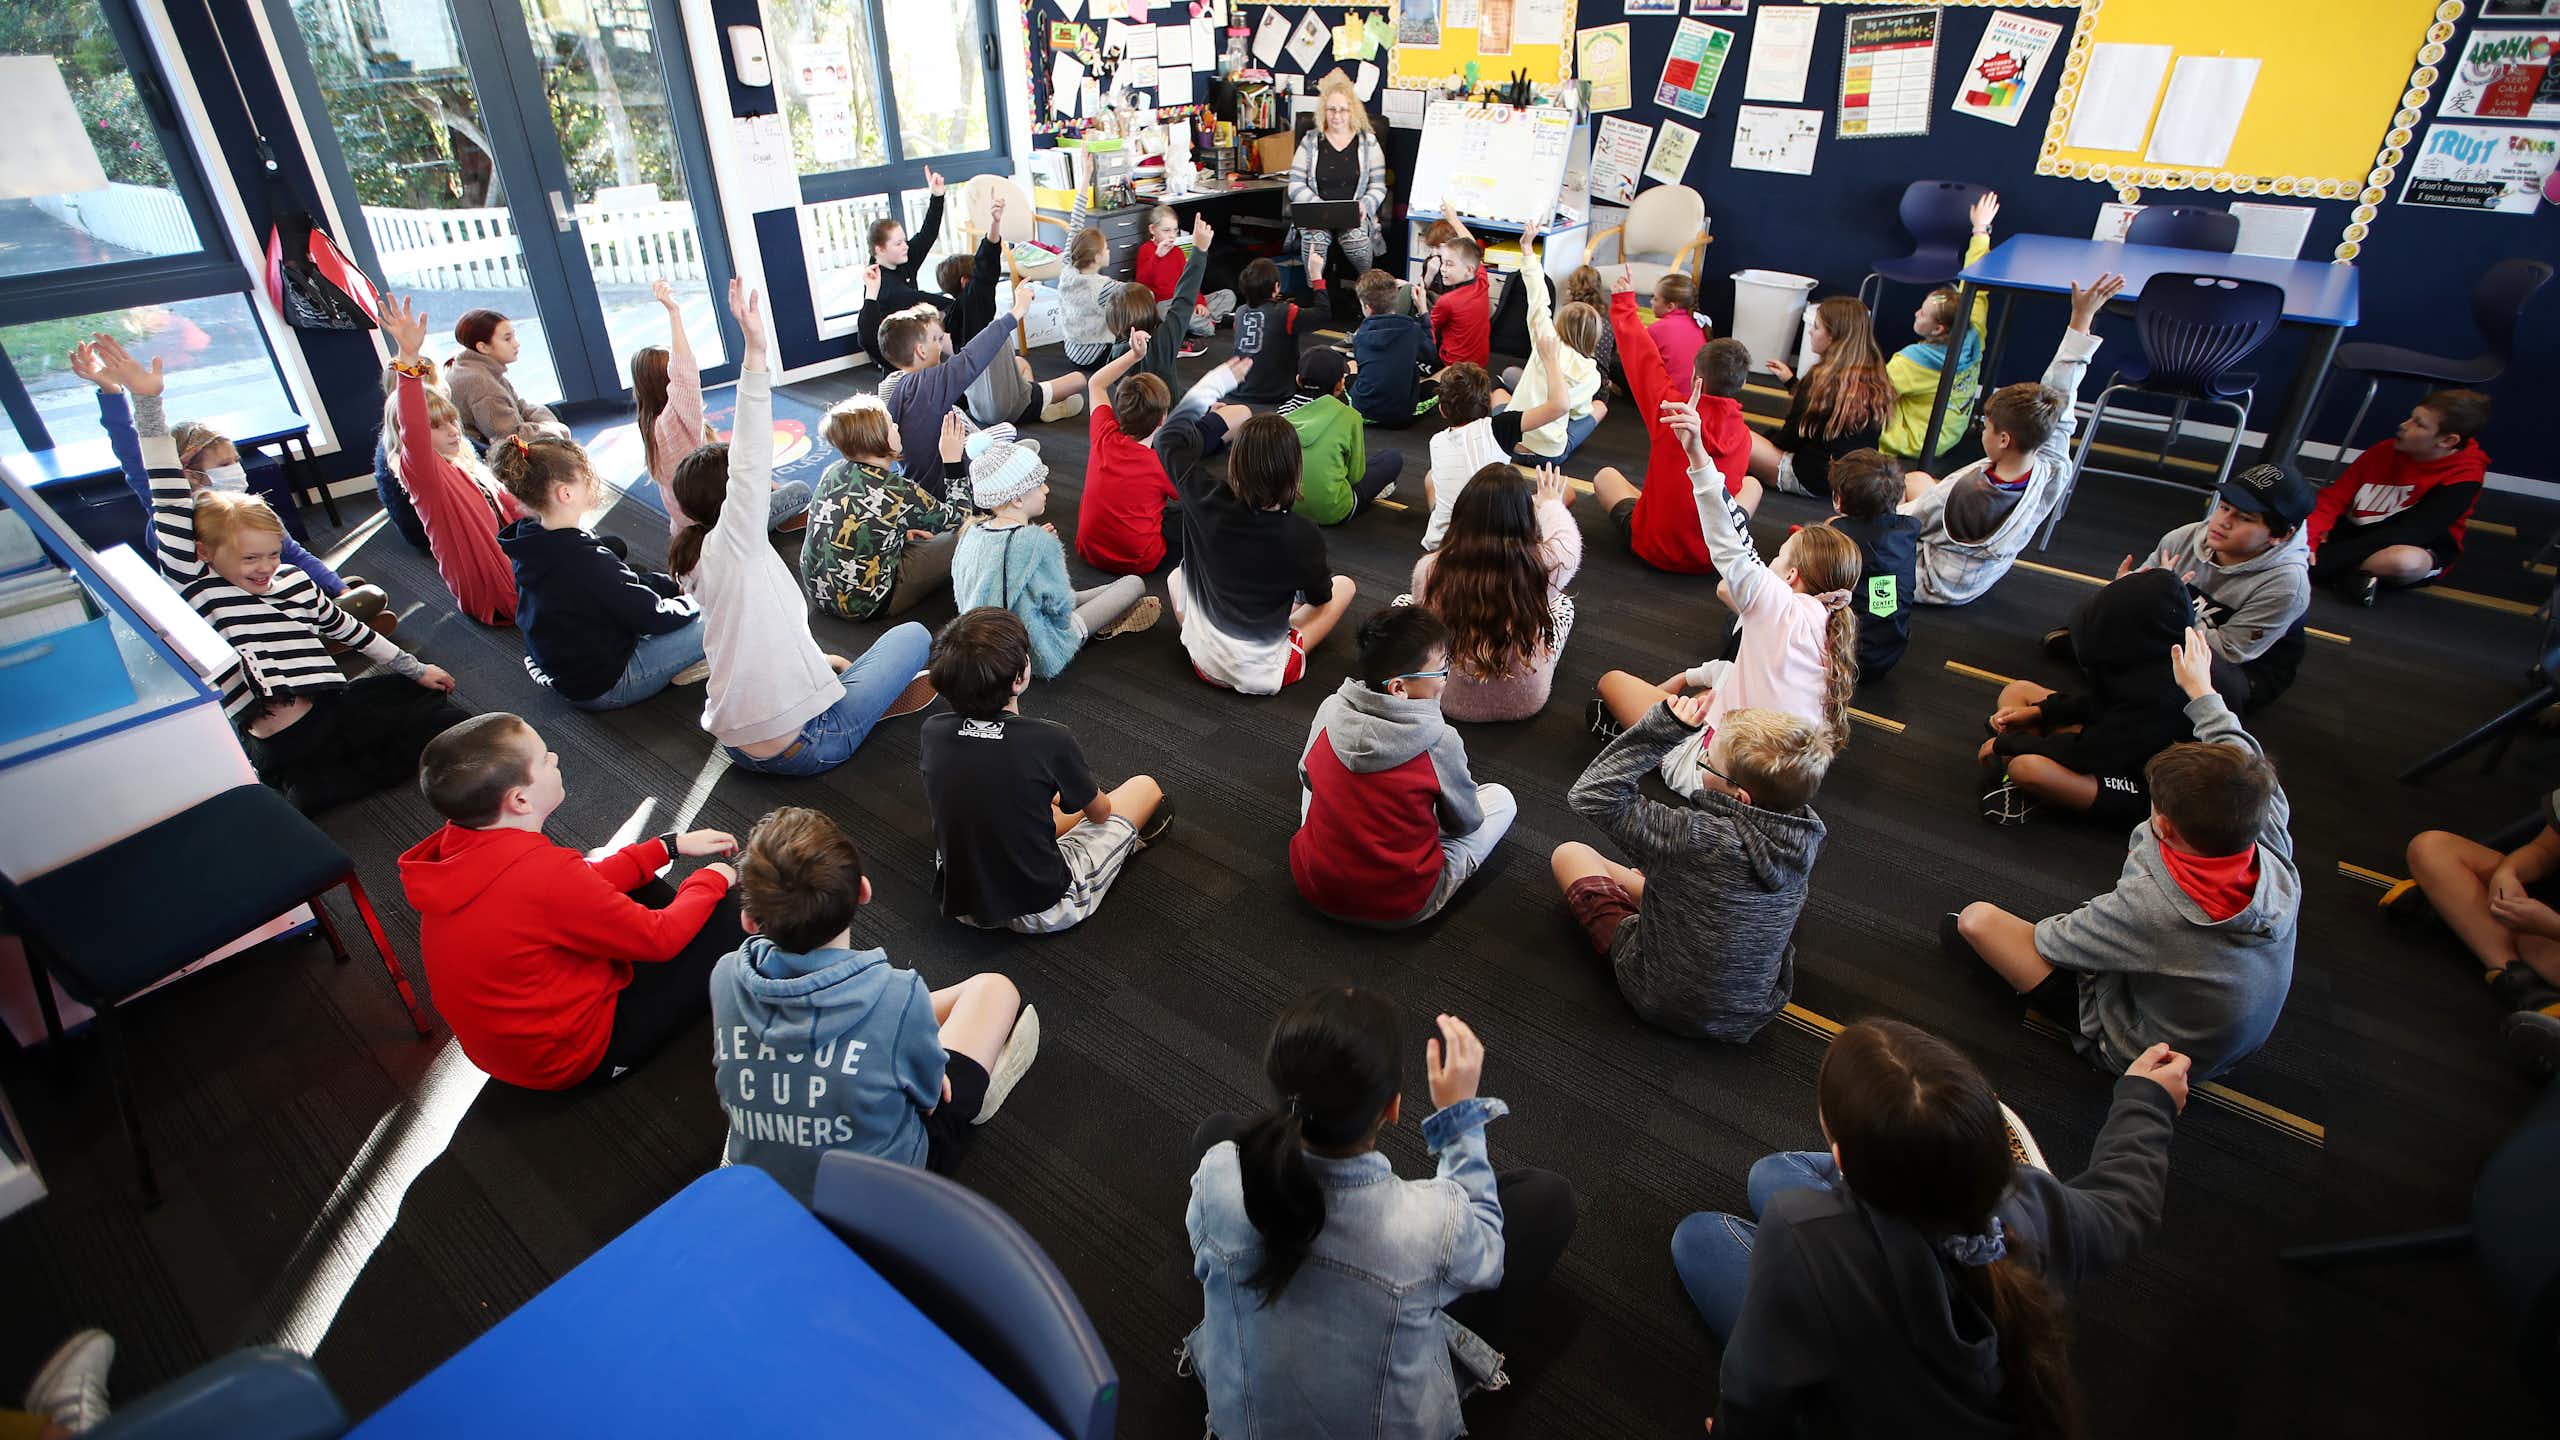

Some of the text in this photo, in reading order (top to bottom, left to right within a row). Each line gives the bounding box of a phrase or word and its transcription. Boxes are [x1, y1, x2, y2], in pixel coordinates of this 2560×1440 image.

[1999, 20, 2018, 30] TAKE
[2467, 36, 2532, 64] AROHA
[2498, 84, 2529, 92] CALM
[2426, 128, 2500, 165] TRUST
[2418, 181, 2442, 190] don't
[2443, 183, 2464, 192] trust
[2424, 193, 2445, 202] trust
[1238, 311, 1265, 354] 3
[2352, 483, 2415, 513] NIKE
[958, 730, 1004, 740] BAD BOY
[718, 1026, 868, 1075] LEAUE
[739, 1068, 827, 1108] CUP
[727, 1103, 853, 1147] WINNERS
